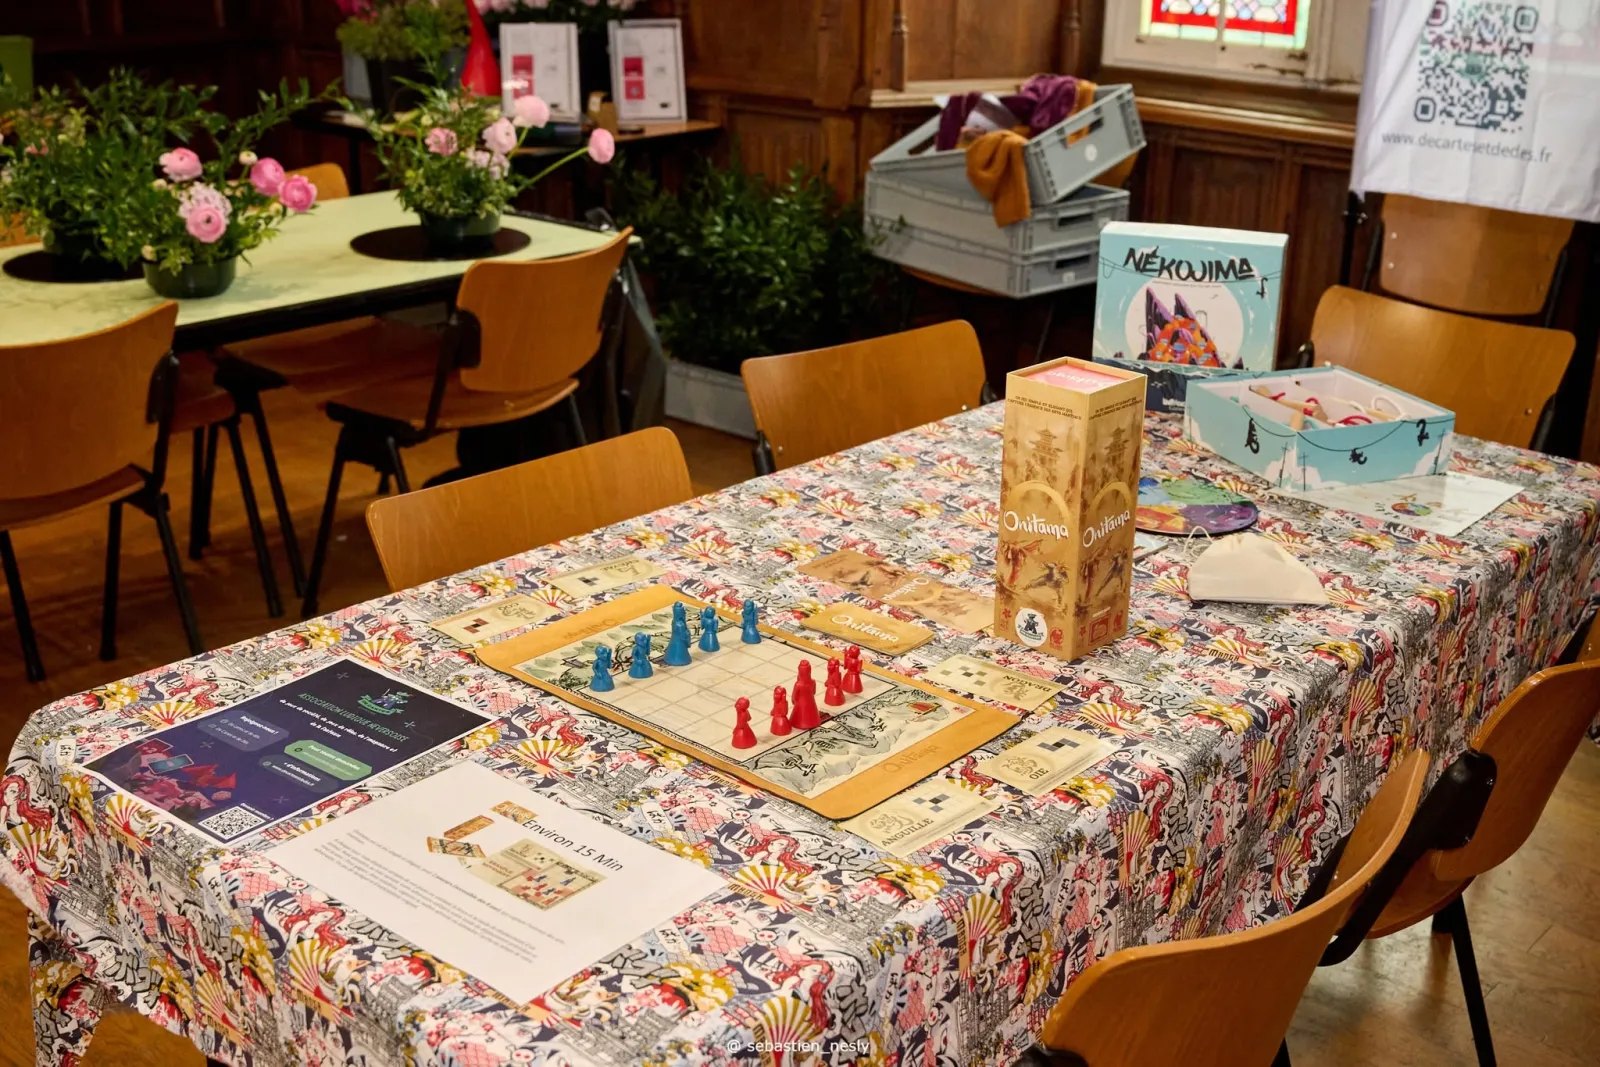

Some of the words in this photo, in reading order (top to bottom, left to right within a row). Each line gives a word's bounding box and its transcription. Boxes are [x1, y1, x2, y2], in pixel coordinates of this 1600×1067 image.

[1003, 510, 1069, 541] Onitama
[1082, 510, 1131, 548] Onitama
[831, 614, 899, 642] Onitama
[1002, 674, 1052, 692] DRAGON
[1029, 767, 1050, 780] OIE
[522, 818, 574, 848] Environ
[573, 845, 596, 858] 15
[595, 853, 624, 872] Min
[881, 817, 935, 847] ANGUILLE
